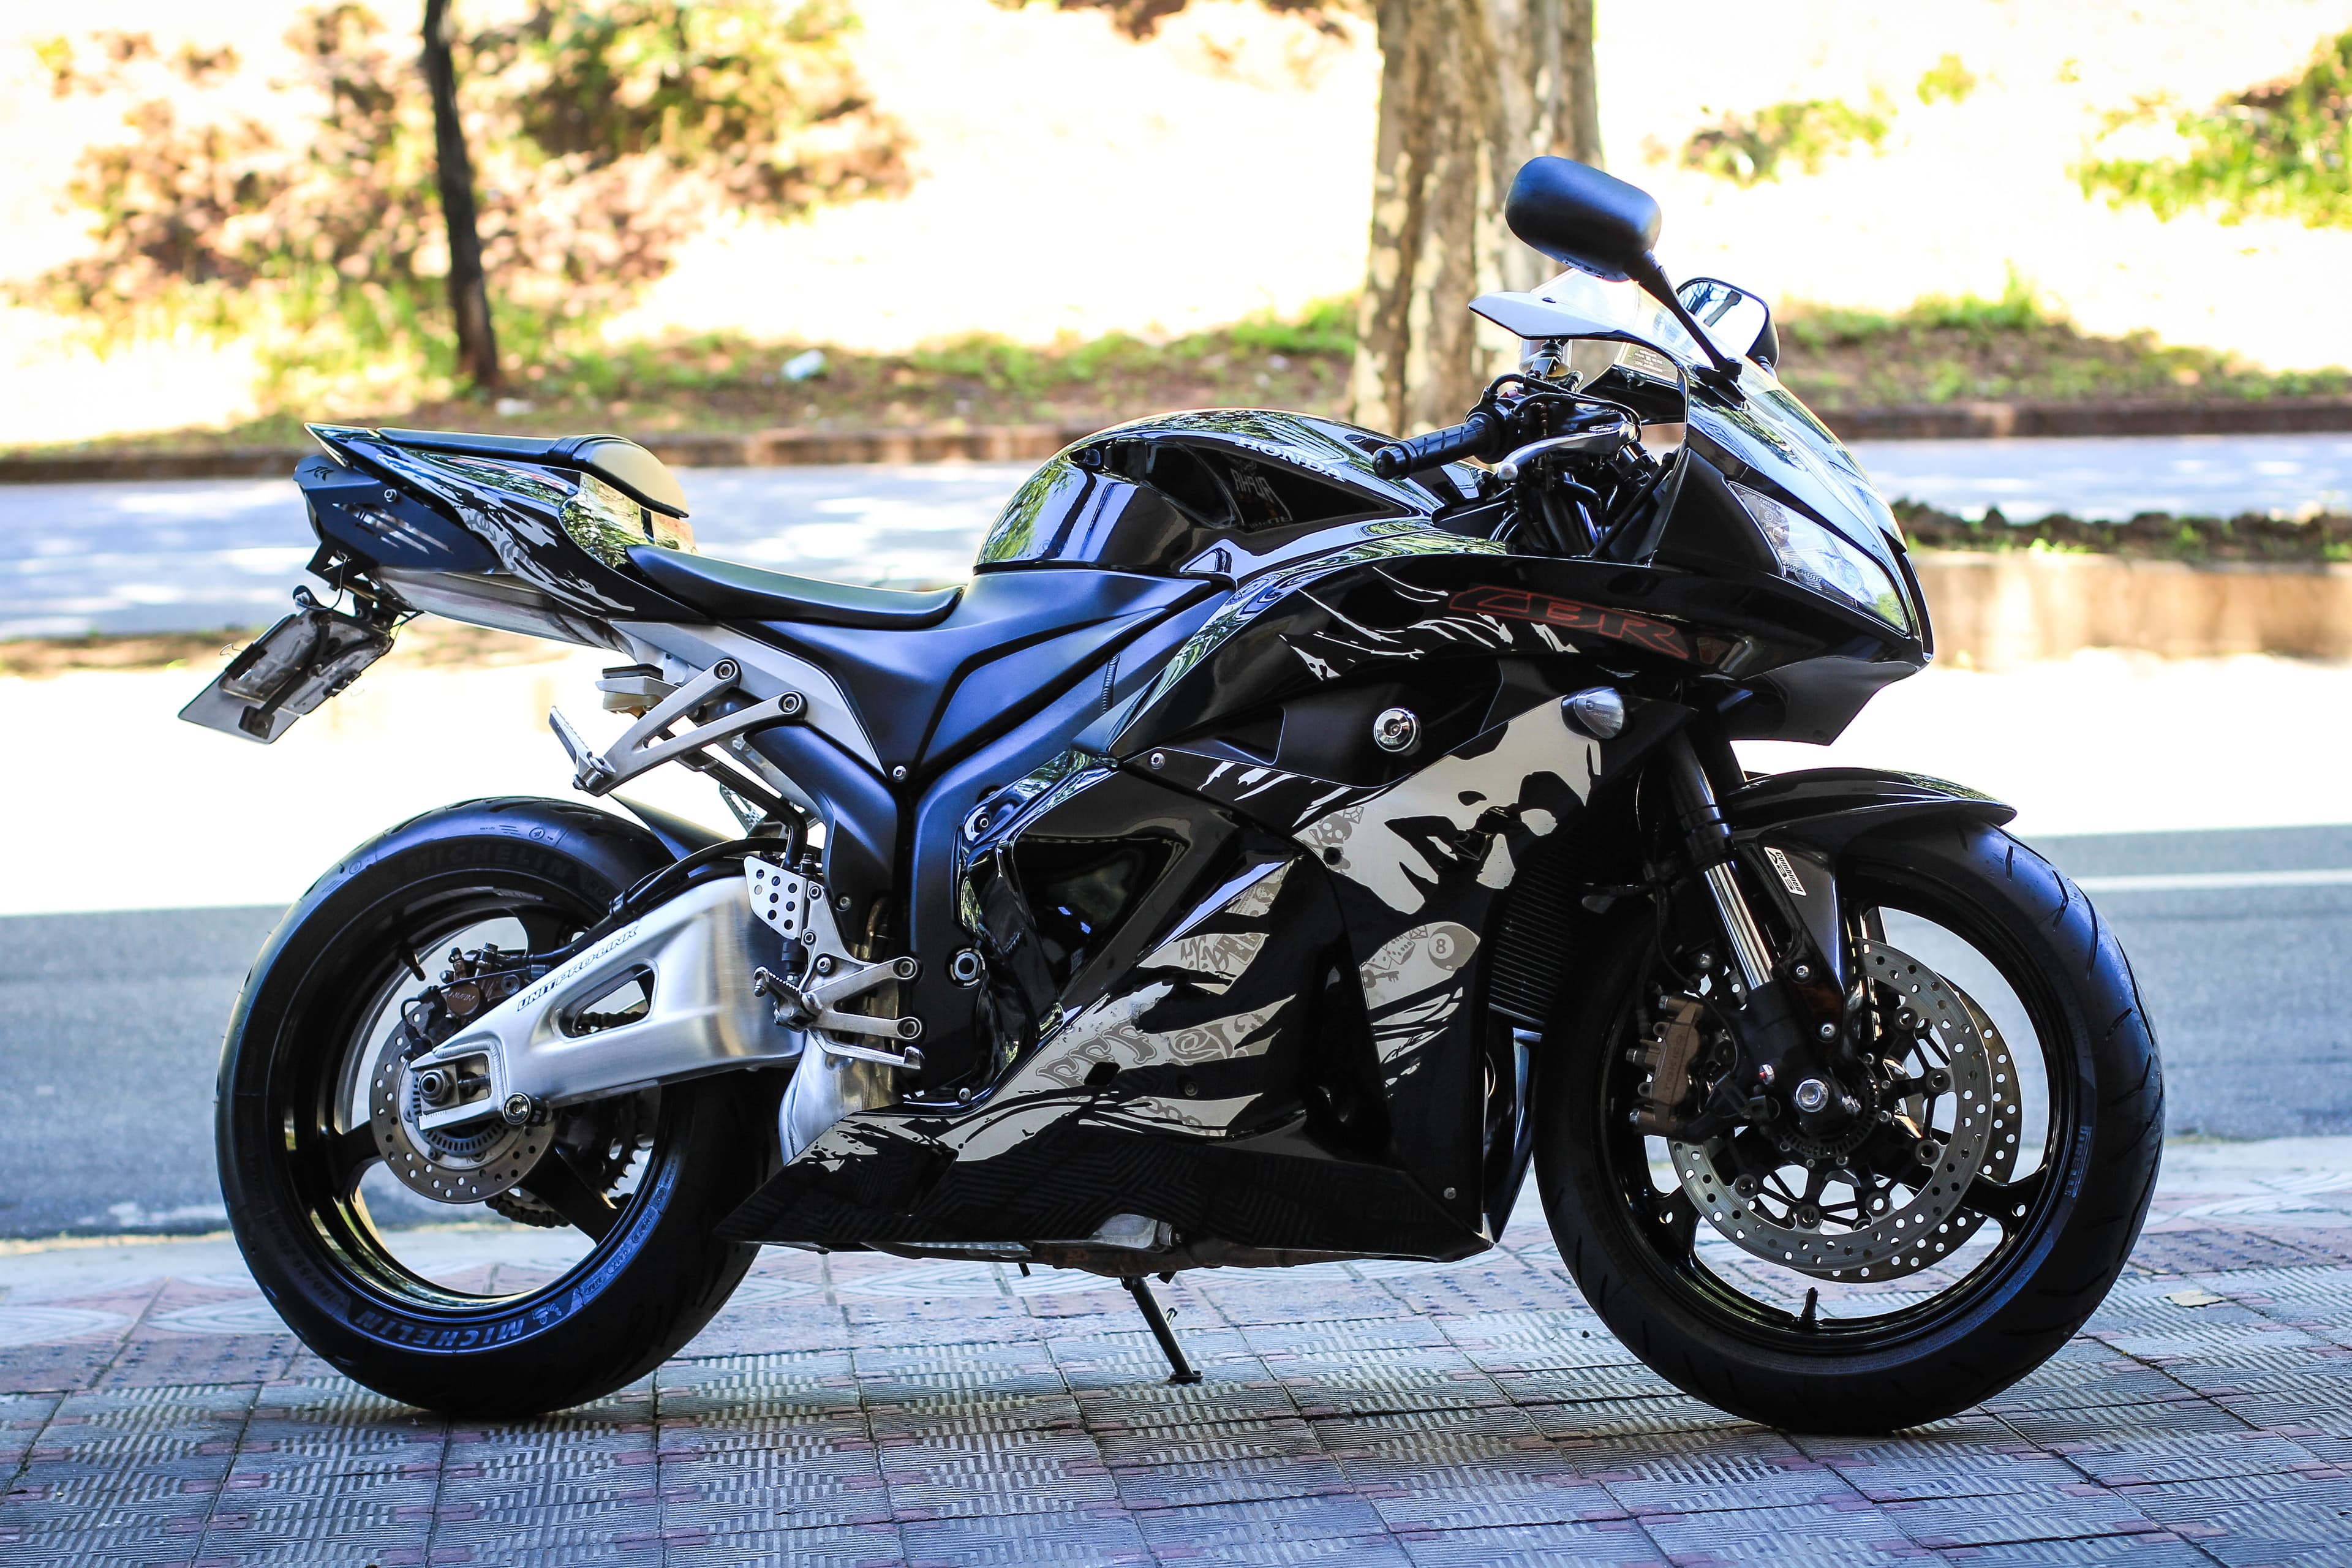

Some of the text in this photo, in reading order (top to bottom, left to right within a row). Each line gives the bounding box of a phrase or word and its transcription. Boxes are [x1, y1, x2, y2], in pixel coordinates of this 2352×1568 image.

[1235, 436, 1346, 483] HONDA
[1449, 585, 1689, 659] CBR
[1767, 850, 1796, 891] ABS
[1776, 852, 1804, 892] Combined
[1435, 938, 1446, 954] 8
[518, 925, 639, 1012] UNIT PRO-LINK
[2064, 1125, 2092, 1198] PIRELLI
[355, 1309, 524, 1346] MICHELIN
